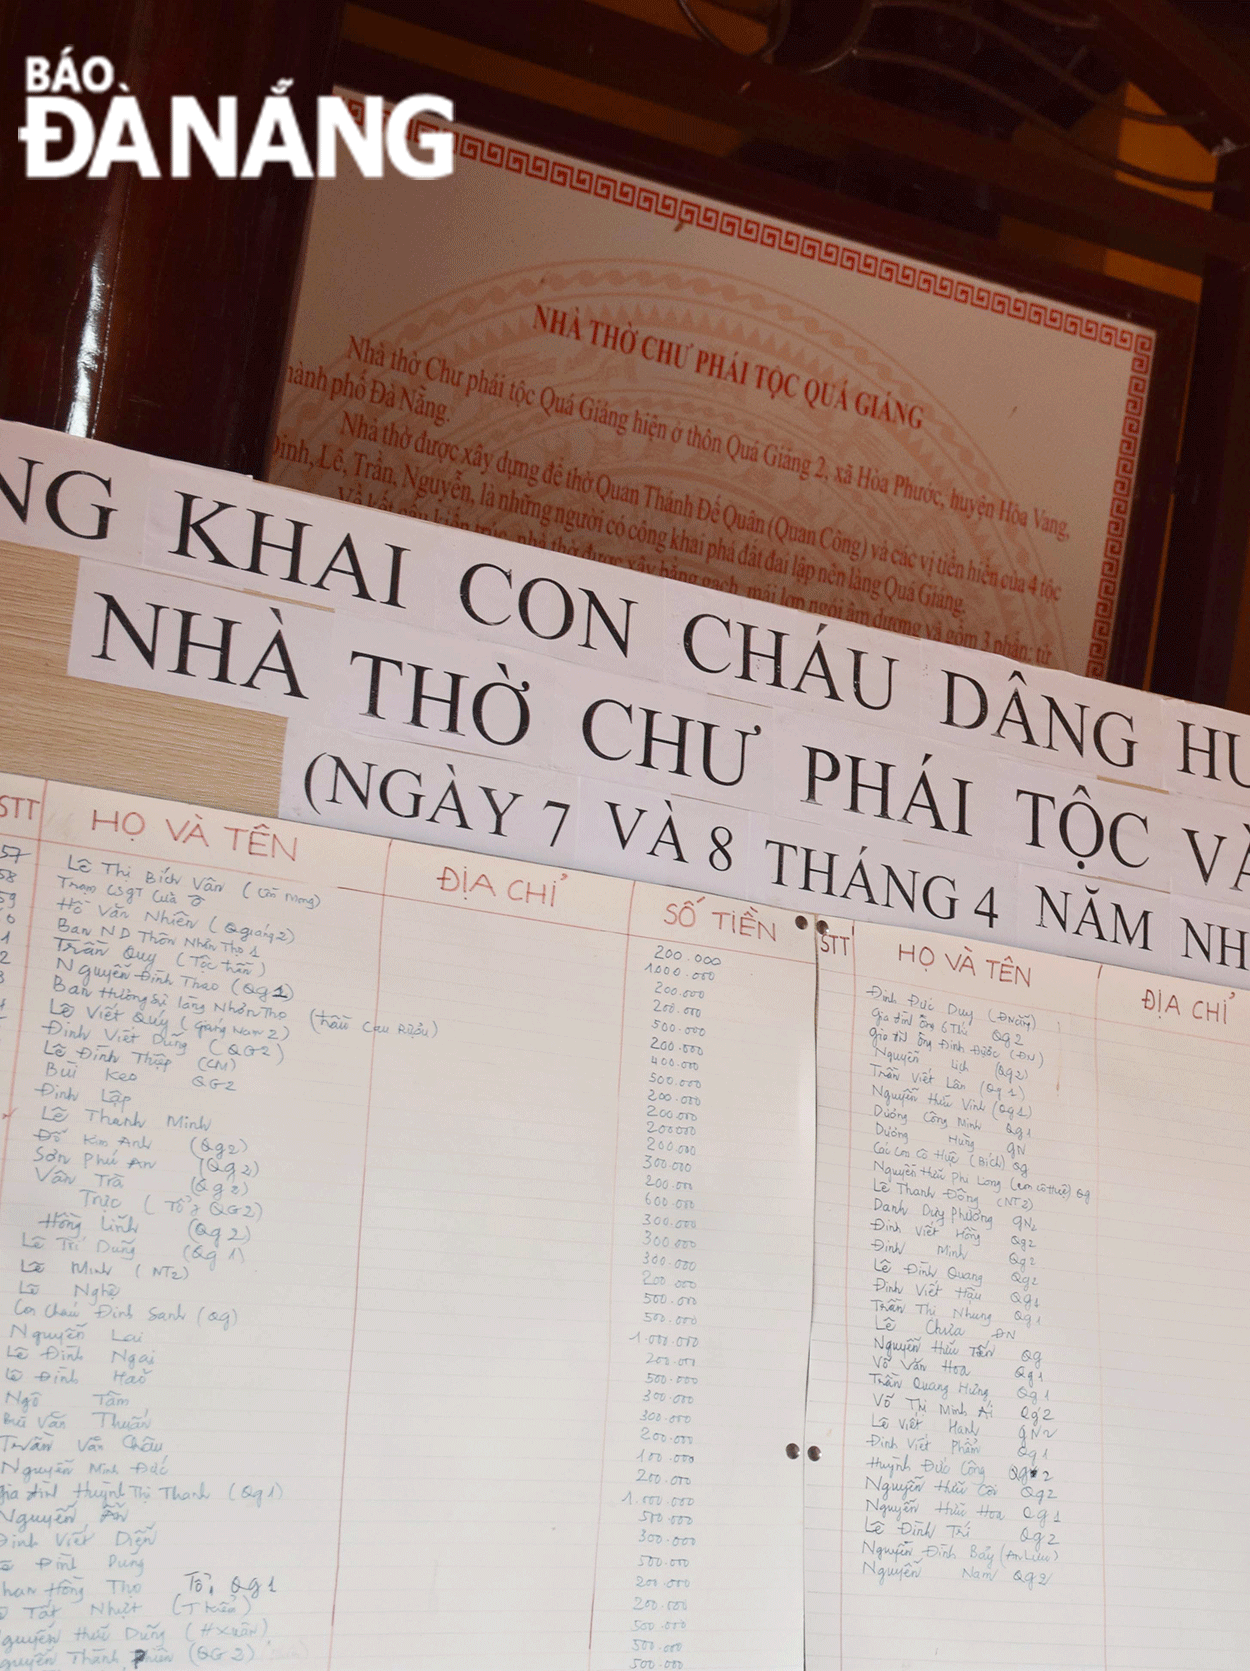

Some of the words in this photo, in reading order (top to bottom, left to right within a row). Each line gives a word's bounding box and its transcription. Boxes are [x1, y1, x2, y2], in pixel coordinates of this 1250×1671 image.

[534, 304, 580, 340] NHÀ
[590, 320, 636, 354] THỜ
[642, 336, 693, 368] CHƯ
[696, 345, 748, 384] PHÁI
[753, 364, 797, 399] TỘC
[330, 370, 366, 400] phố
[370, 379, 395, 408] Đà
[347, 335, 385, 366] Nhà
[391, 348, 421, 375] thờ
[425, 357, 463, 387] Chư
[466, 369, 505, 398] phái
[509, 380, 535, 406] tộc
[540, 386, 574, 416] Quá
[633, 410, 667, 440] hiện
[687, 425, 722, 453] thôn
[815, 456, 830, 481] 2,
[834, 464, 853, 484] xã
[857, 466, 889, 494] Hòa
[950, 488, 995, 518] huyện
[999, 500, 1027, 527] Hòa
[1031, 508, 1071, 543] Vang,
[167, 490, 411, 609] KHAI
[459, 563, 638, 659] CON
[683, 613, 900, 711] CHÁU
[939, 669, 1138, 769] DÂNG
[91, 591, 309, 700] NHÀ
[350, 650, 530, 746] THỜ
[582, 698, 762, 787] CHƯ
[802, 745, 973, 837] PHÁI
[1016, 784, 1149, 870] TỘC
[91, 809, 146, 841] HỌ
[165, 813, 209, 847] VÀ
[223, 823, 297, 861] TÊN
[304, 753, 523, 837] (NGÀY
[544, 800, 570, 847] 7
[604, 799, 689, 864] VÀ
[708, 826, 733, 872] 8
[766, 840, 959, 921] THÁNG
[974, 886, 999, 929] 4
[1036, 885, 1153, 951] NĂM
[437, 866, 496, 900] ĐỊA
[507, 873, 568, 907] CHỈ
[663, 896, 706, 928] SỐ
[821, 934, 850, 956] STT
[898, 944, 935, 971] HỌ
[945, 946, 976, 976] VÀ
[986, 956, 1031, 987] TÊN
[1192, 992, 1236, 1024] CHỈ
